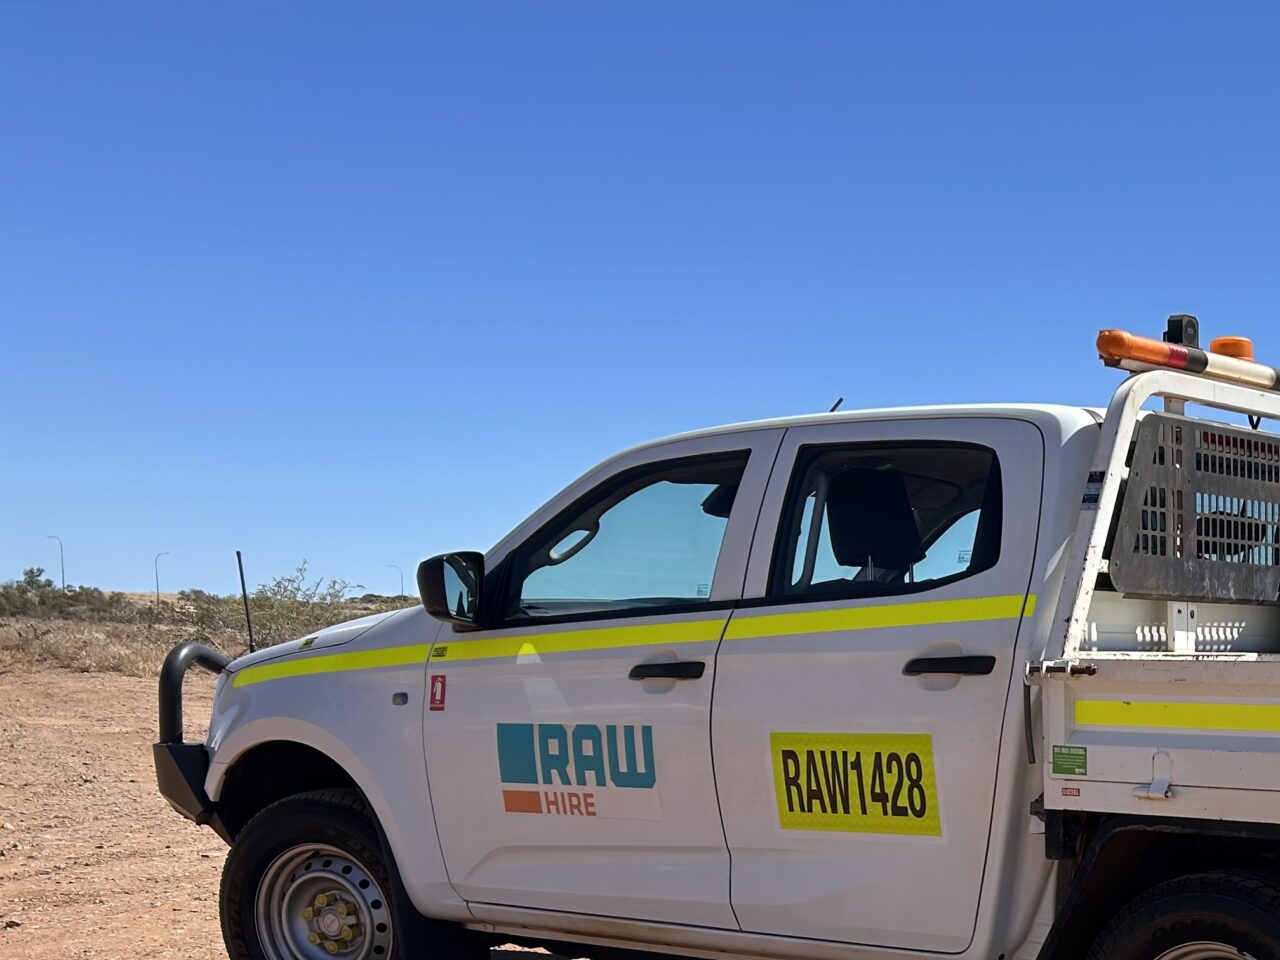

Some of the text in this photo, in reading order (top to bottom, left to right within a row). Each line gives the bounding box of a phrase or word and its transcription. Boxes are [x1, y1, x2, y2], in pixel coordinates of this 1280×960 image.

[538, 723, 657, 788] RAW
[781, 749, 927, 819] RAW1428
[544, 791, 597, 816] HIRE
